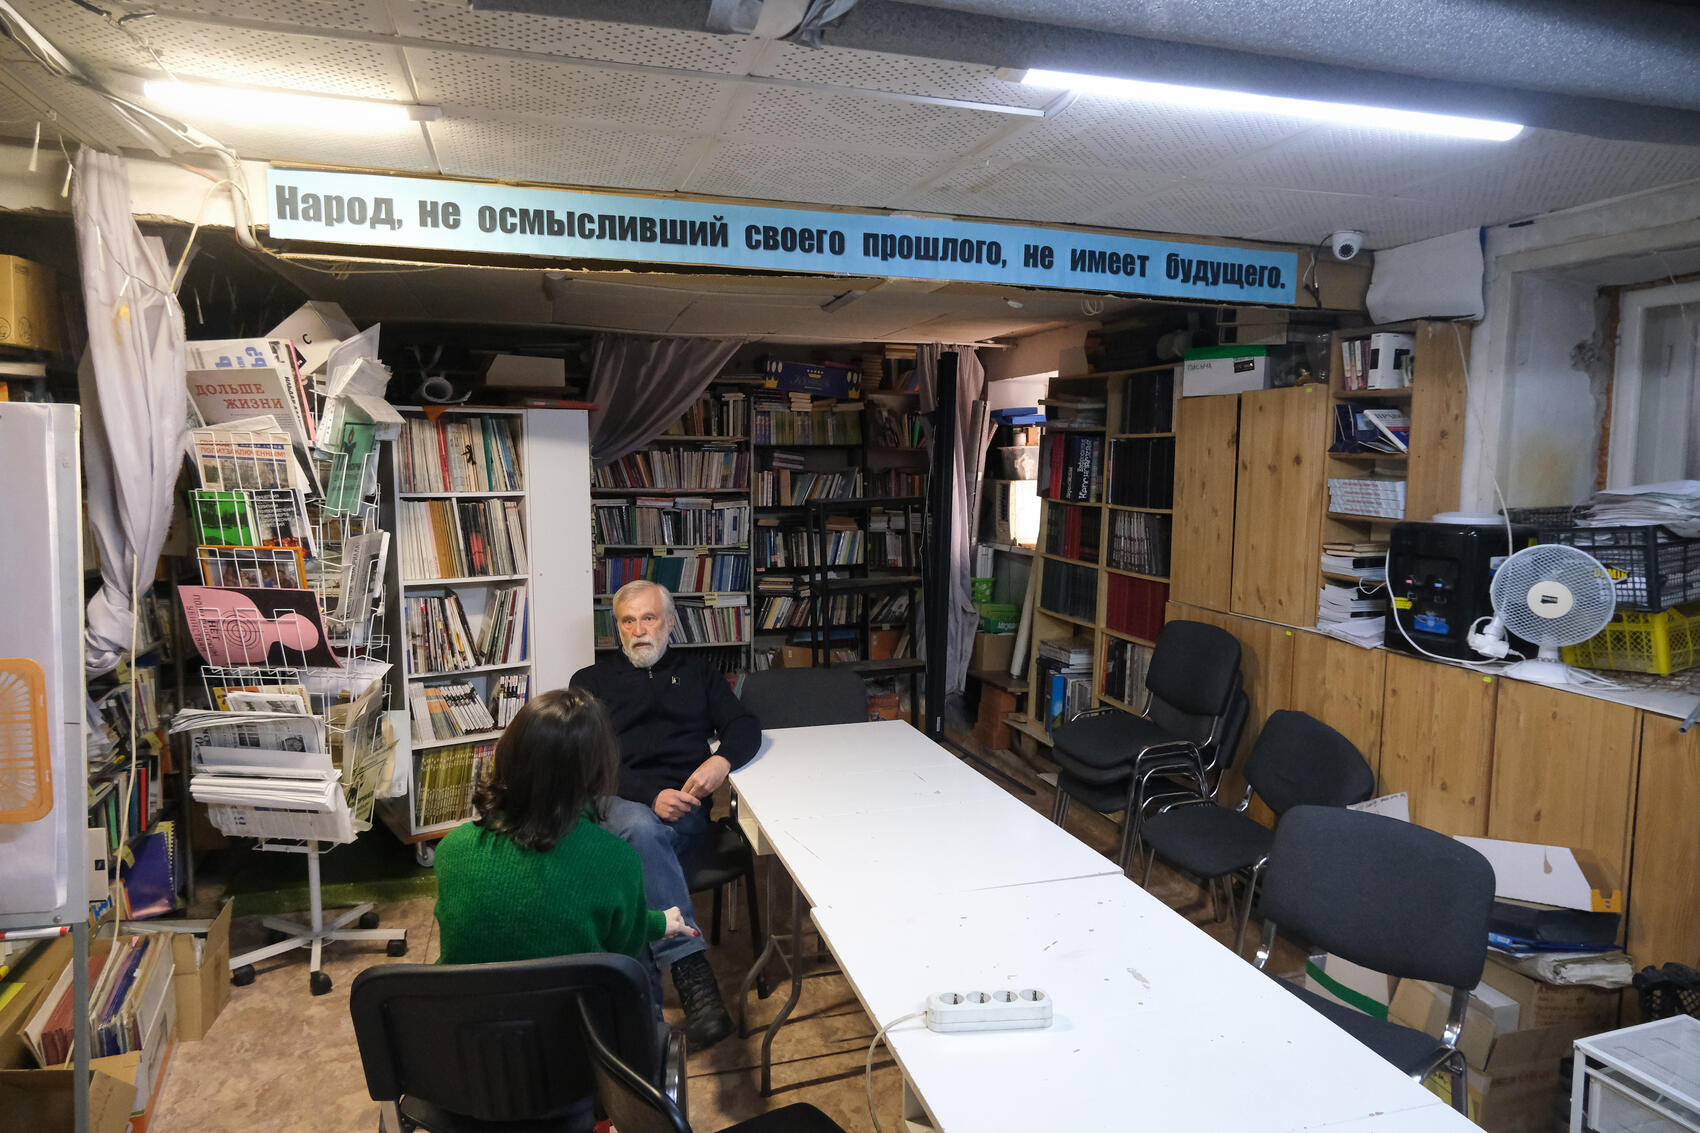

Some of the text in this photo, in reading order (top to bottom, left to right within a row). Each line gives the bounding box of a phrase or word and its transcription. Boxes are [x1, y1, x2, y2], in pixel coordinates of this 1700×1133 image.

[274, 184, 1286, 291] Народ, не осмысливший своего прошлого, не имеет будущего.
[195, 383, 265, 397] ДОЛЬШЕ
[223, 398, 284, 409] ЖИЗНИ
[207, 620, 220, 640] НЕТ
